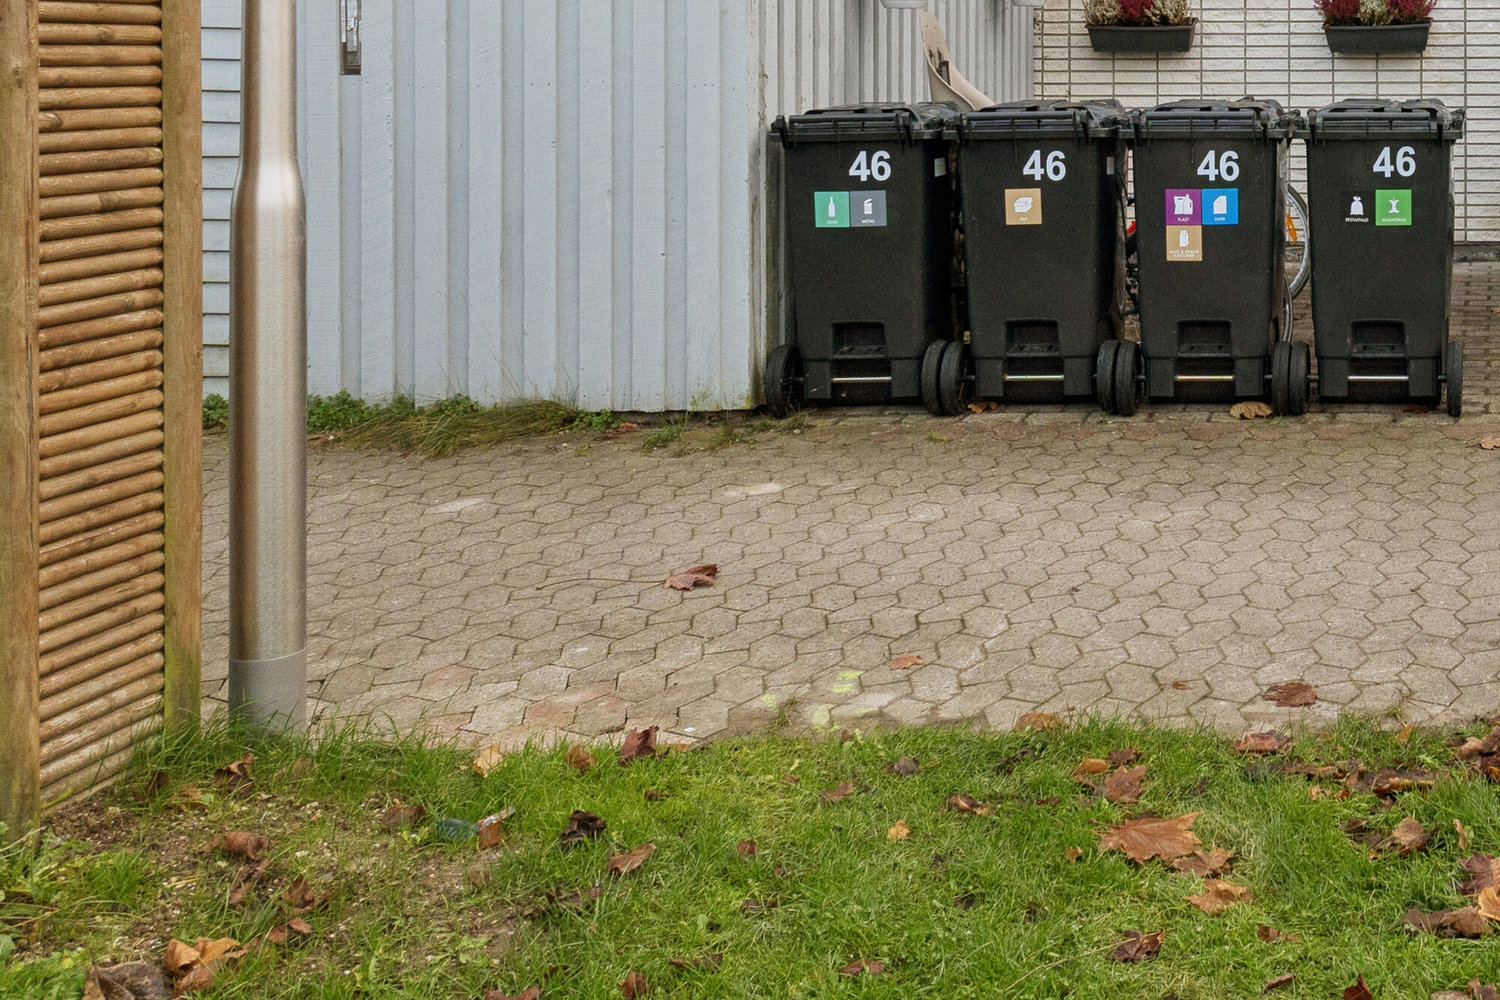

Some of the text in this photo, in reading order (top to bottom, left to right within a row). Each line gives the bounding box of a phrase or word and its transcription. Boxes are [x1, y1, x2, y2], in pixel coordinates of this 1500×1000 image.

[849, 150, 892, 182] 46
[1023, 149, 1067, 182] 46
[1197, 150, 1240, 182] 46
[1373, 146, 1416, 178] 46
